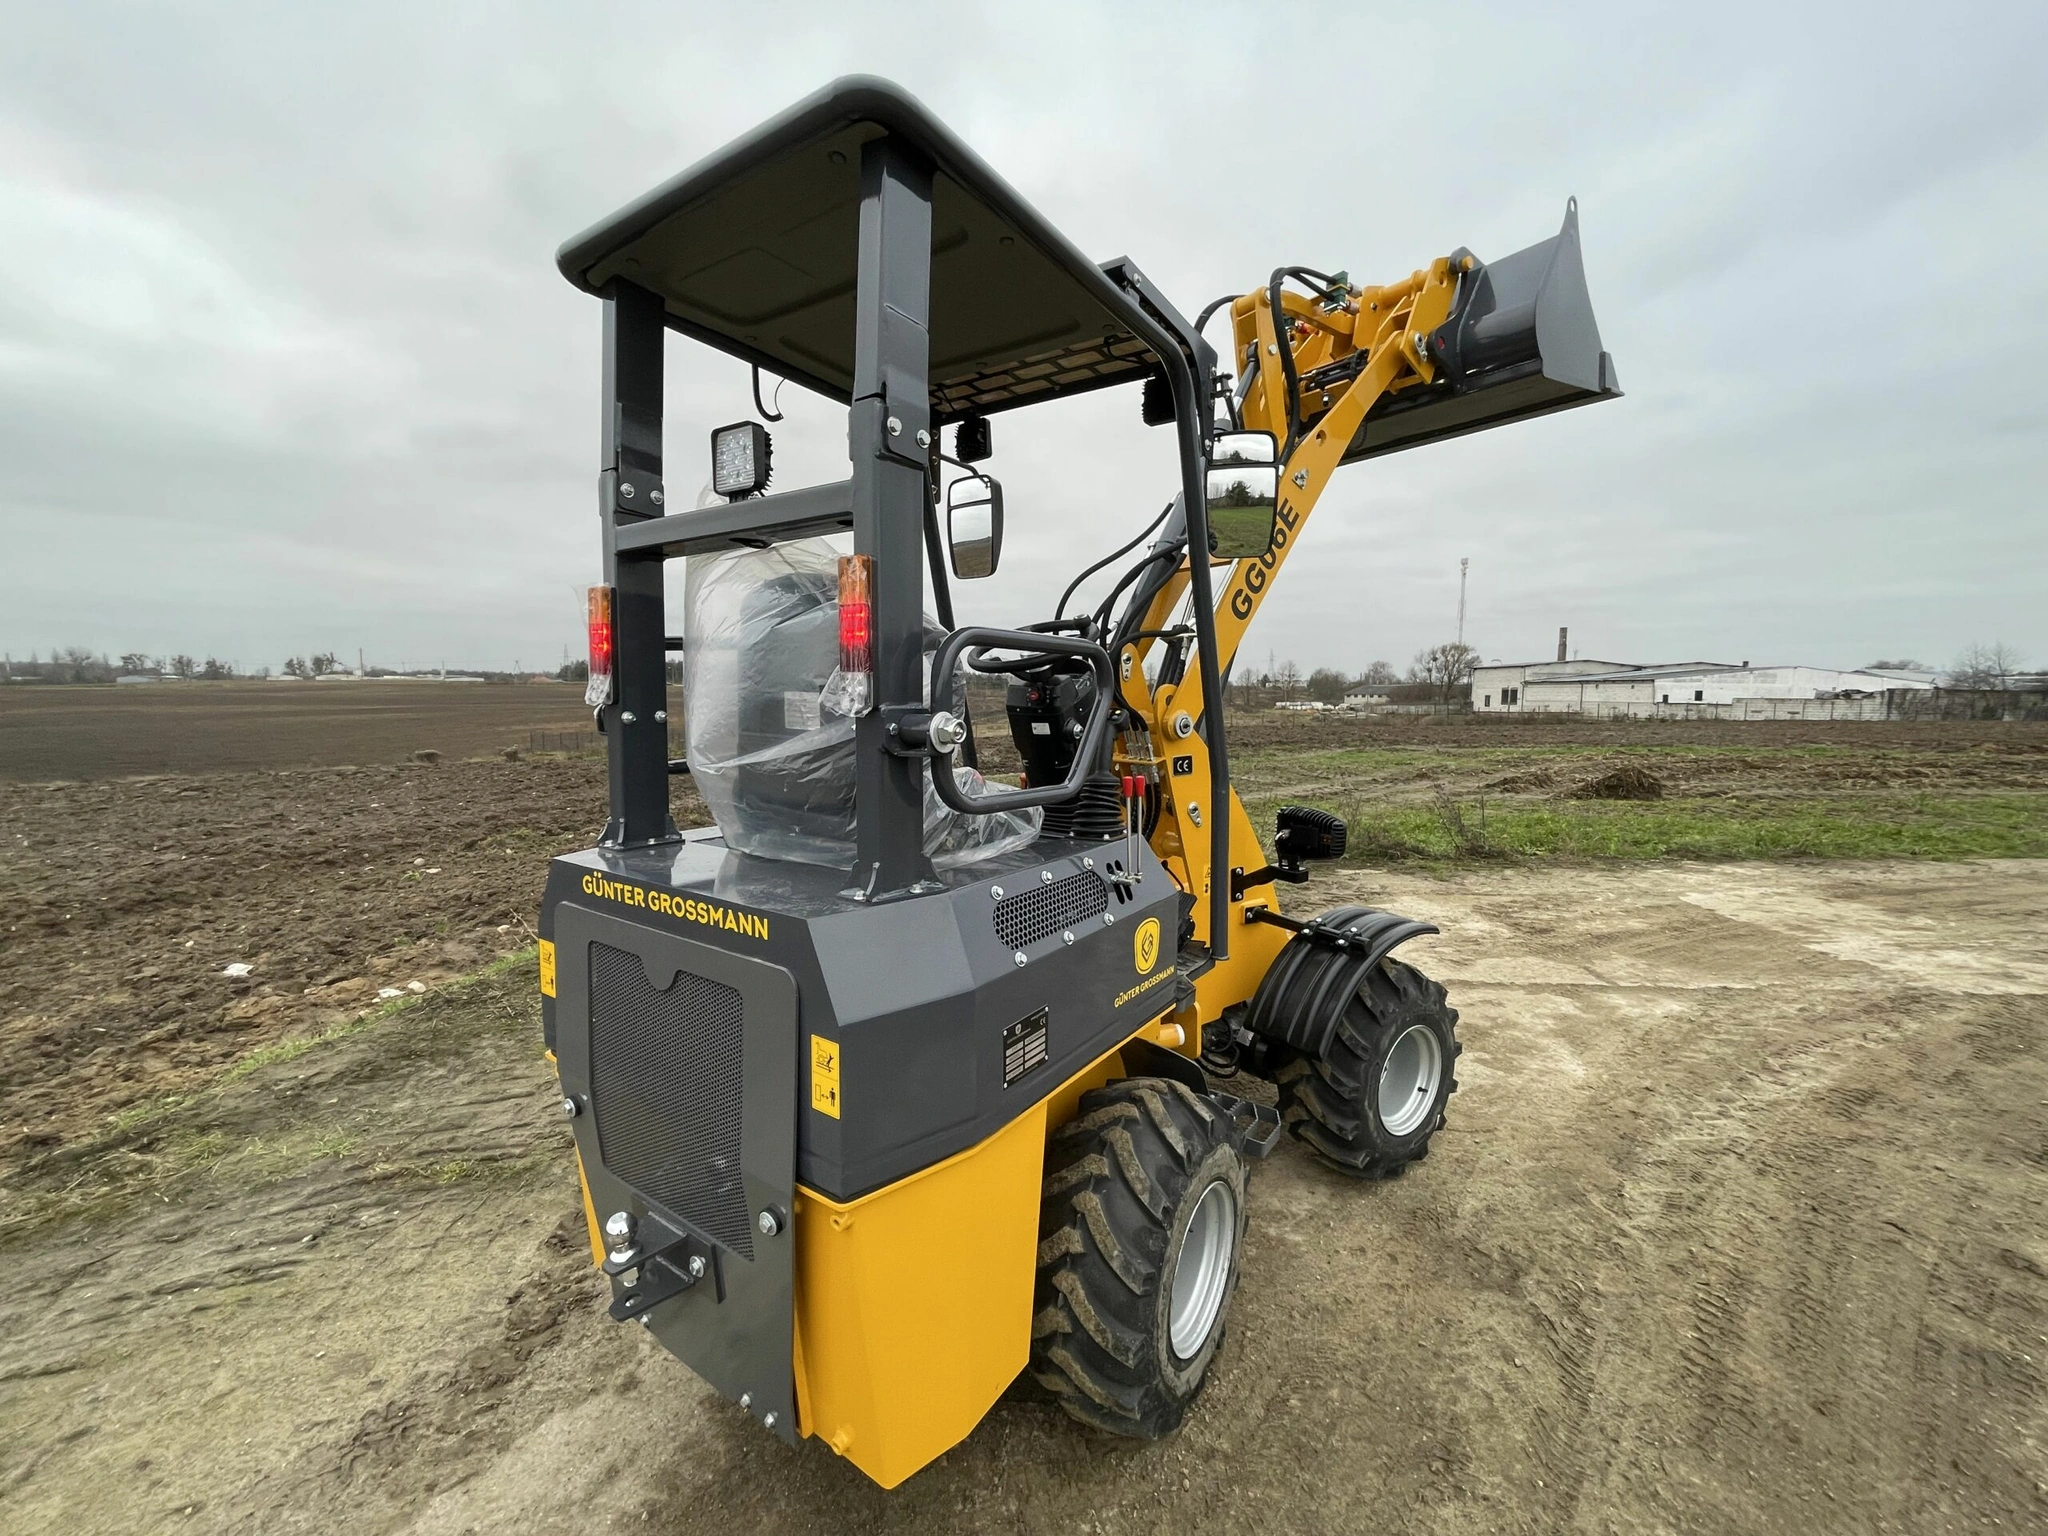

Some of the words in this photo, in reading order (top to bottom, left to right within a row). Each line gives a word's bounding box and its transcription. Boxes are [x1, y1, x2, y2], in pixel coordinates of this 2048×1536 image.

[1176, 759, 1189, 772] CE
[582, 871, 645, 907] GÜNTER
[647, 890, 769, 941] GROSSMANN
[1113, 985, 1140, 1008] GÜNTER
[1139, 964, 1175, 992] GROSSMANN
